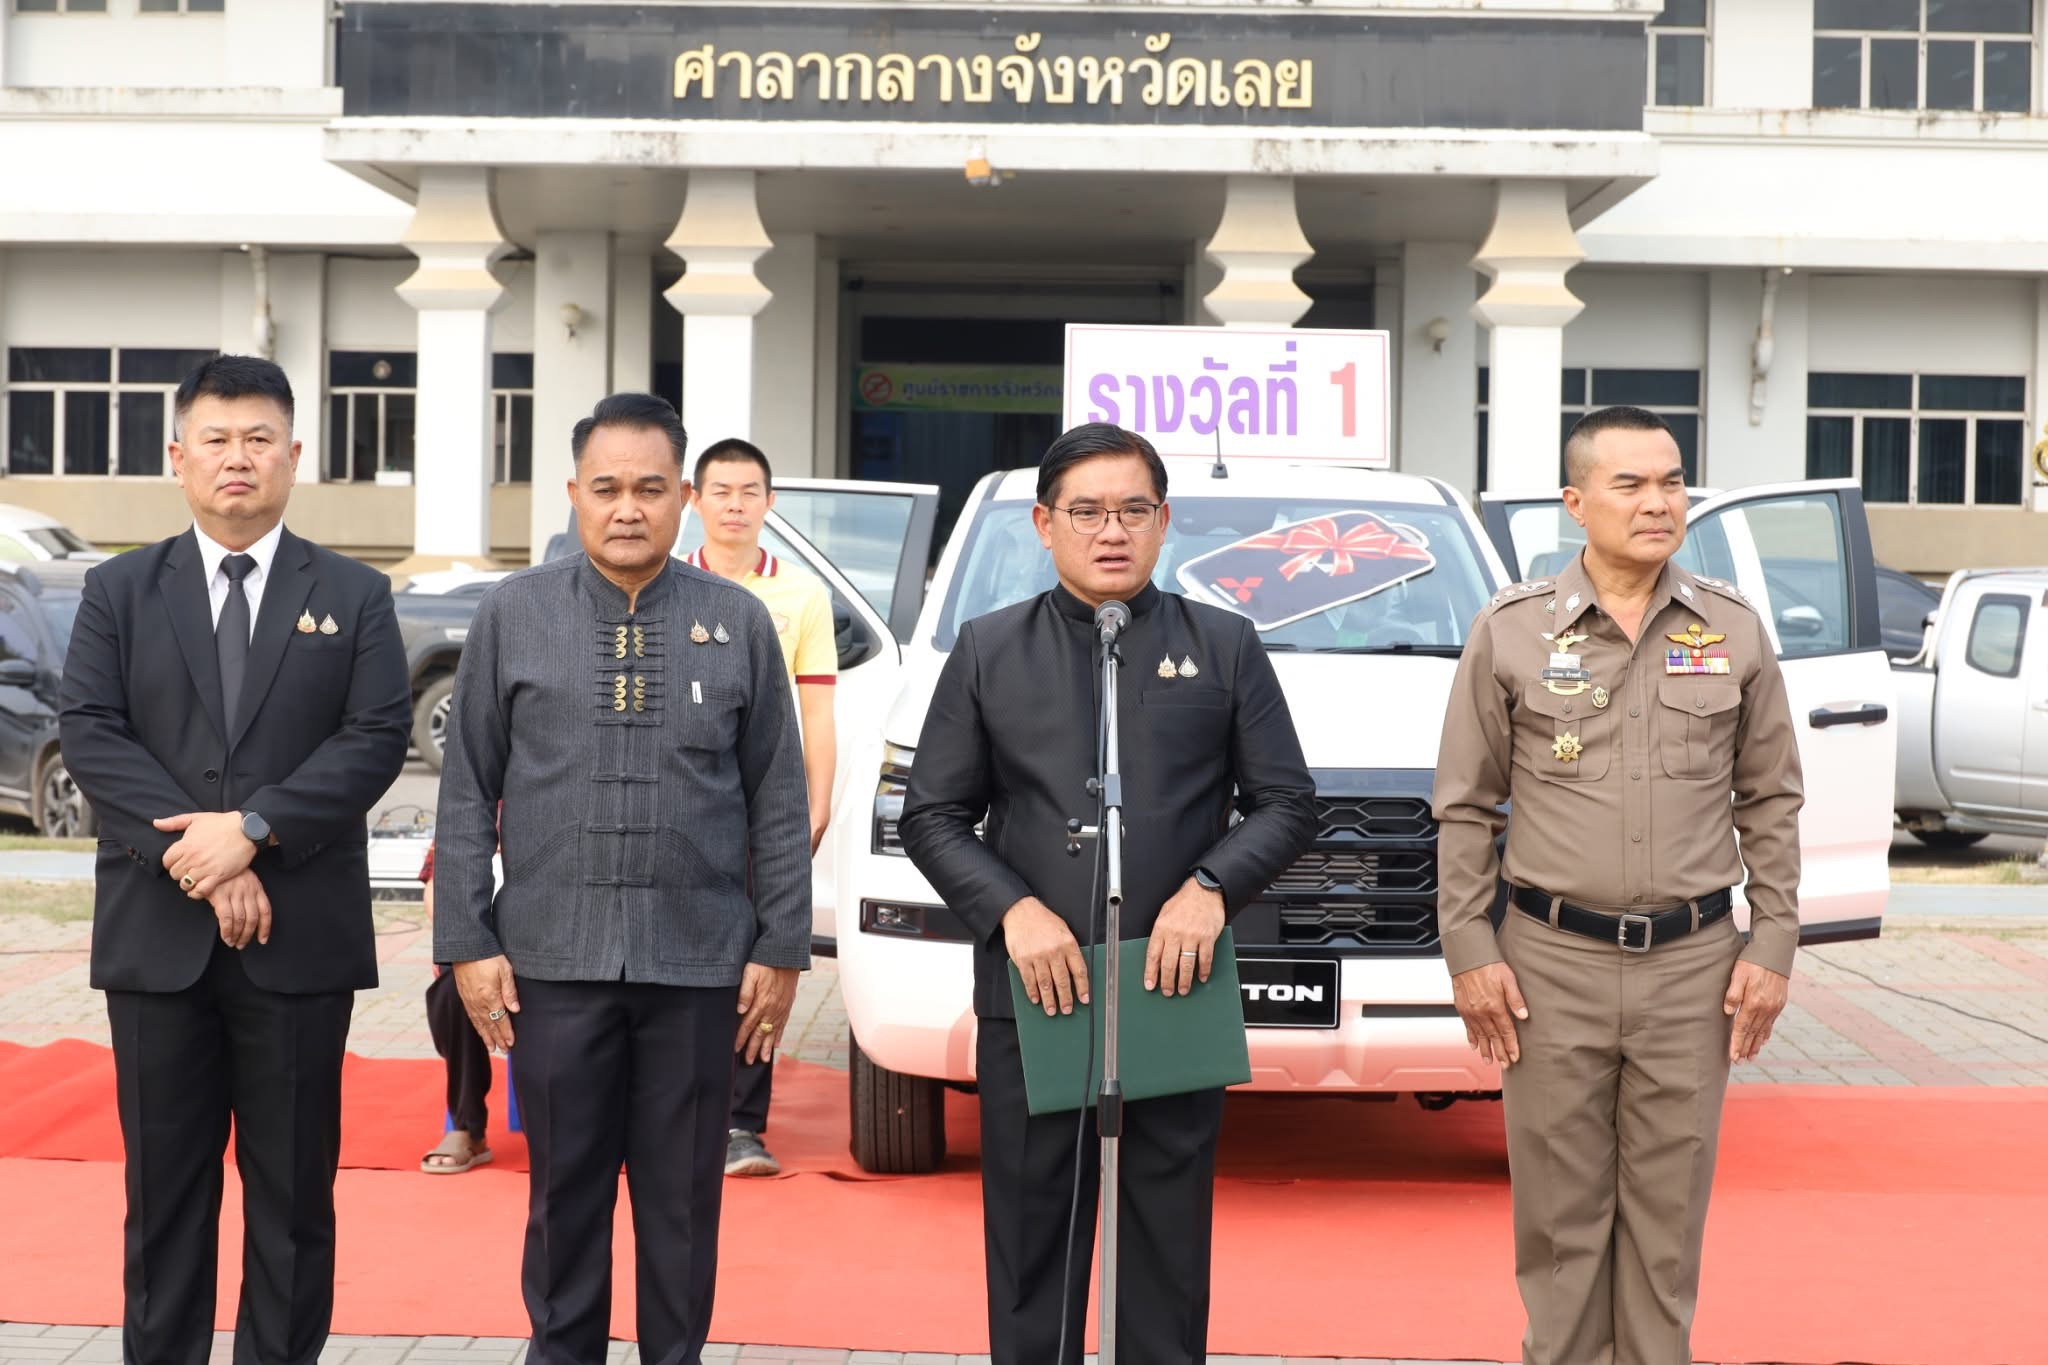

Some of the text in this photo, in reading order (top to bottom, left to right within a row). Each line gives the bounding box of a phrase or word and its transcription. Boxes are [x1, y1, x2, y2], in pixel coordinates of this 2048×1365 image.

[673, 32, 1313, 109] ศาลากลางจังหวัดเลย
[1087, 340, 1357, 438] รางวัลที่ 1
[1239, 983, 1324, 1002] TON
